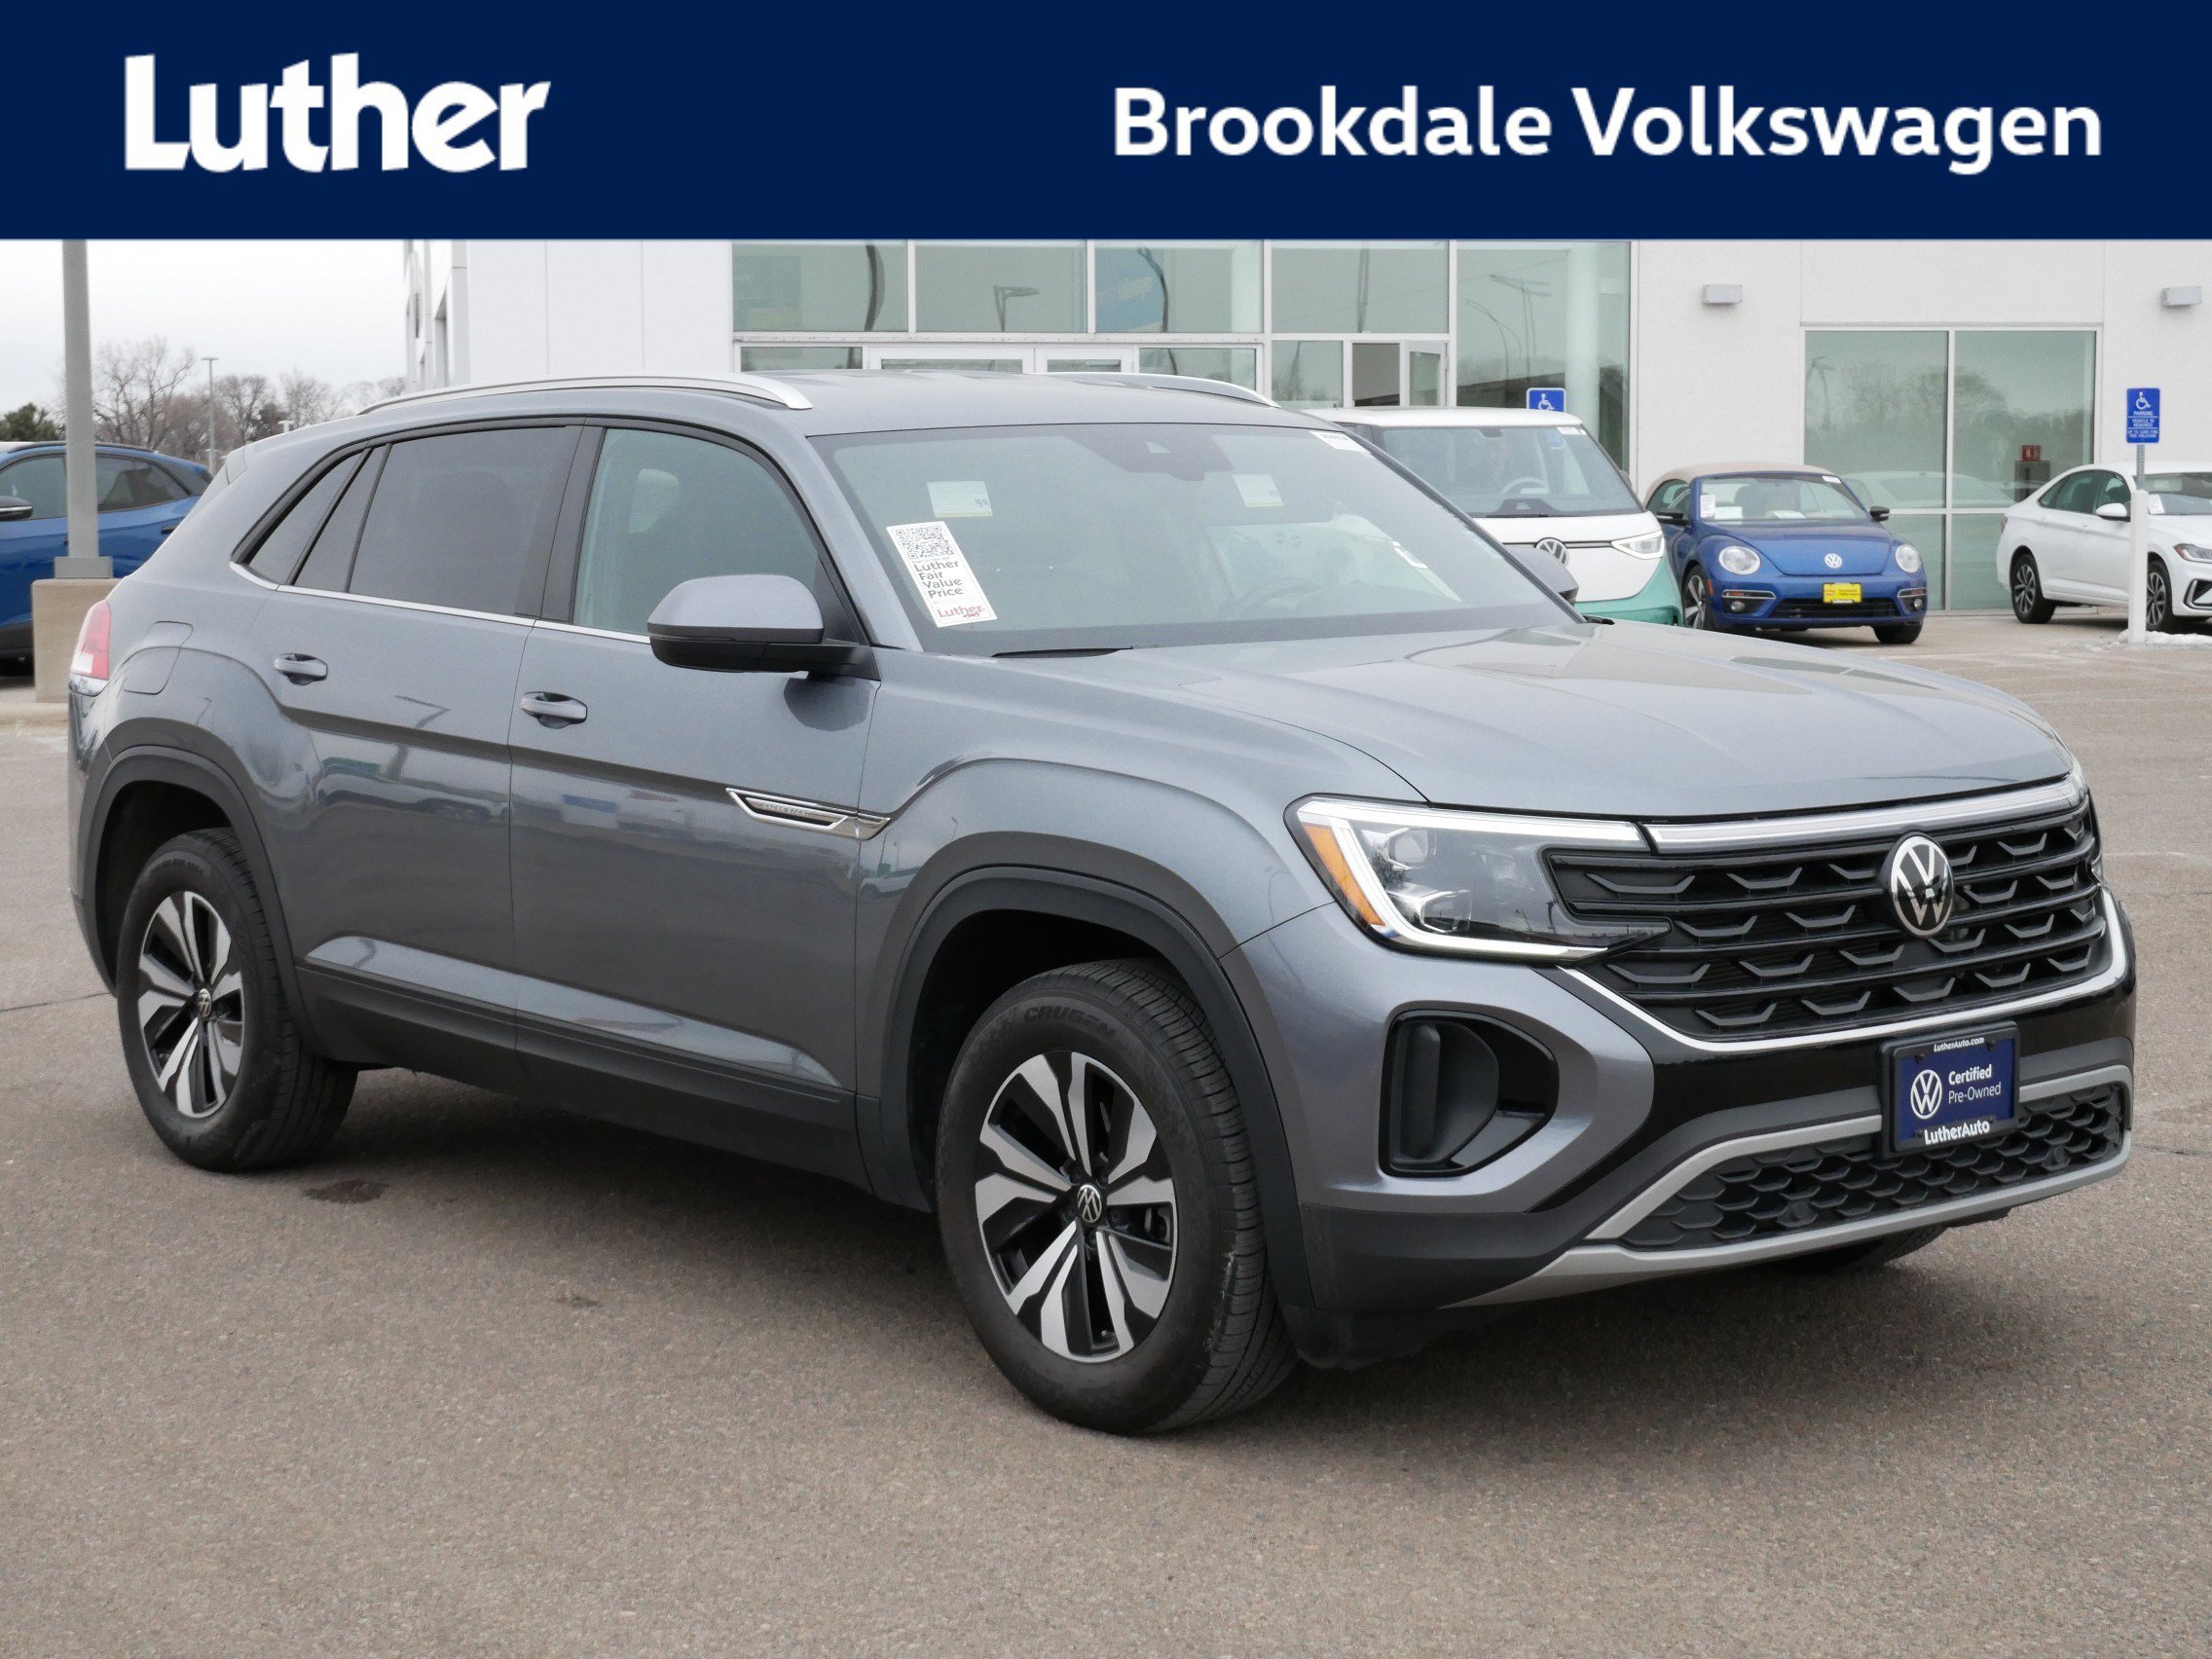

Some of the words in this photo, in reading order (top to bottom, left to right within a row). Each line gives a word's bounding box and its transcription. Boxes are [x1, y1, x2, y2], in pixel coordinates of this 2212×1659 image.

[913, 561, 959, 572] Luther
[918, 571, 943, 581] Fair
[922, 578, 963, 589] Value
[927, 588, 964, 599] Price
[937, 605, 981, 618] Luther
[1933, 1037, 1985, 1052] LutherAuto.com
[1948, 1063, 1992, 1086] Certified
[1948, 1081, 2002, 1105] Pre-Owned
[1924, 1119, 1991, 1146] LutherAuto
